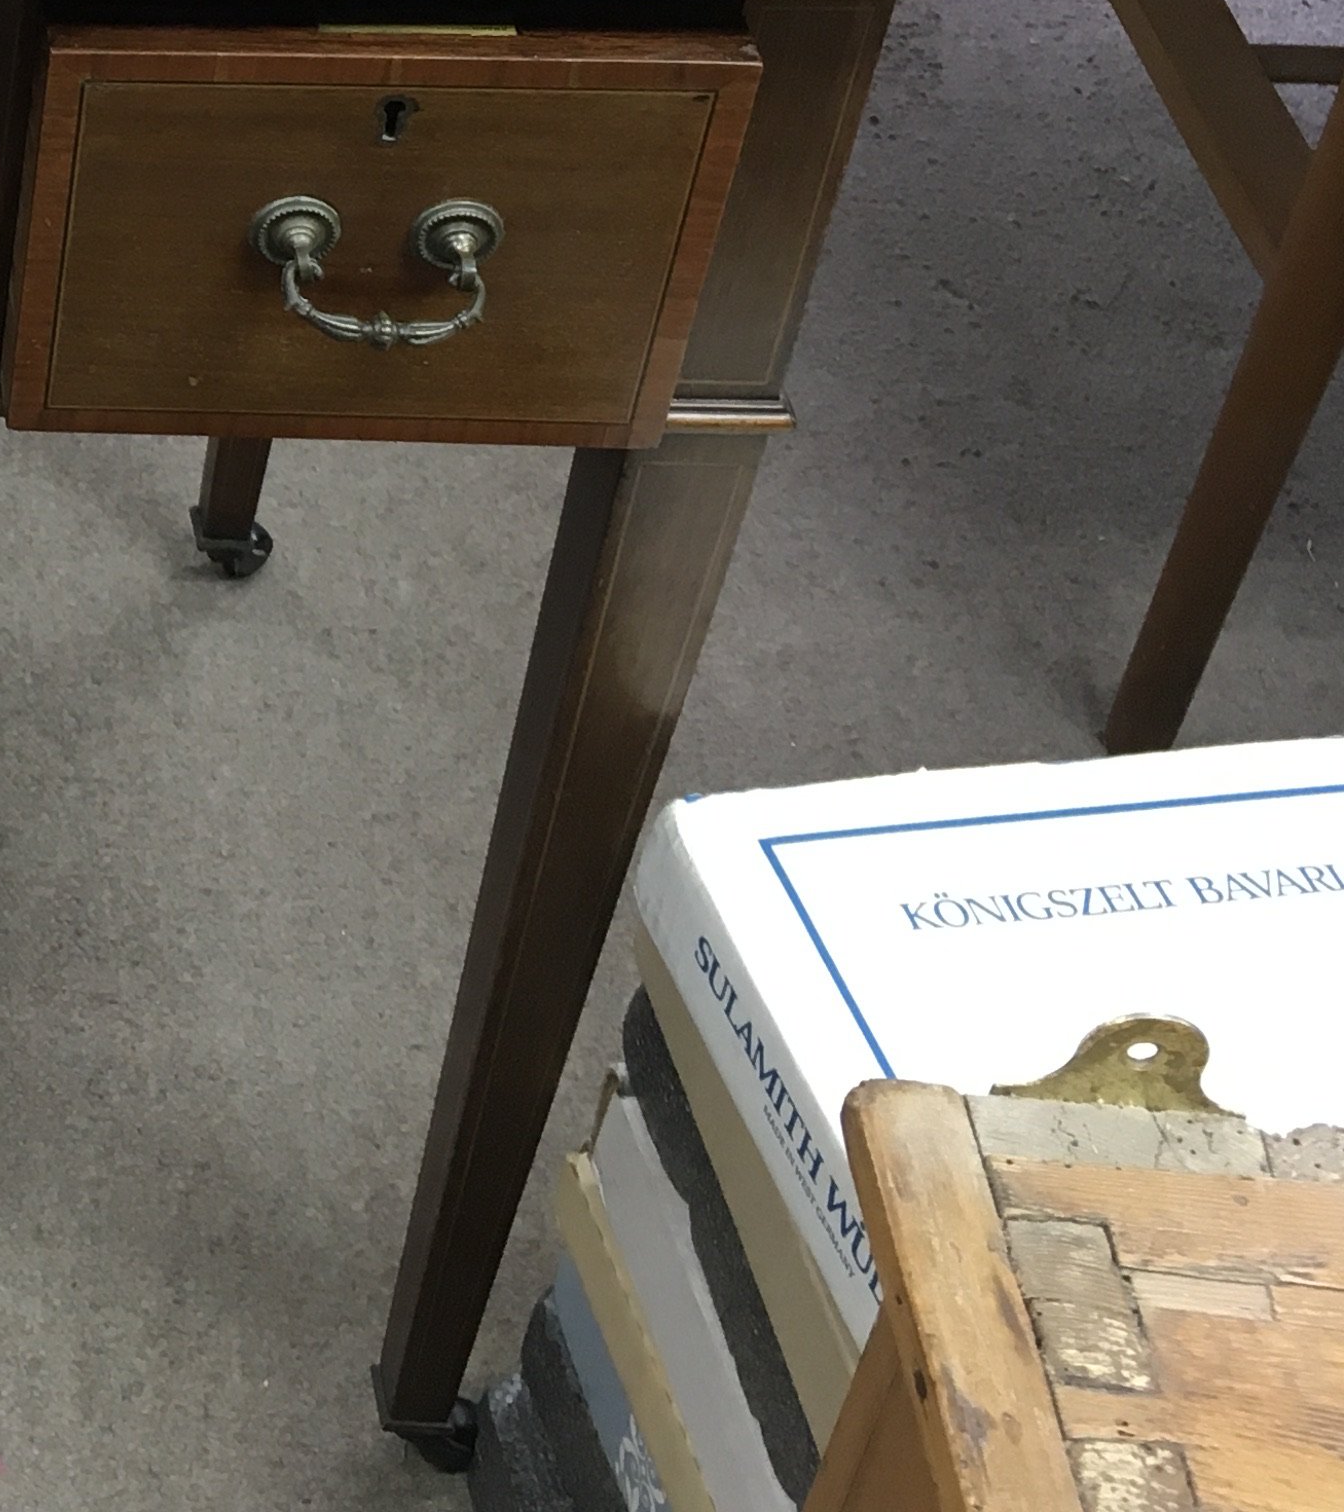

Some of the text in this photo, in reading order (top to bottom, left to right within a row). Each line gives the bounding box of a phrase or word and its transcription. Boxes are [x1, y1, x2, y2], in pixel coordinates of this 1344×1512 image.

[900, 864, 1344, 930] KÖNIGSZELT BAVARI
[694, 935, 825, 1185] SULAMITH
[762, 1104, 856, 1279] MADE IN WEST GERMANY
